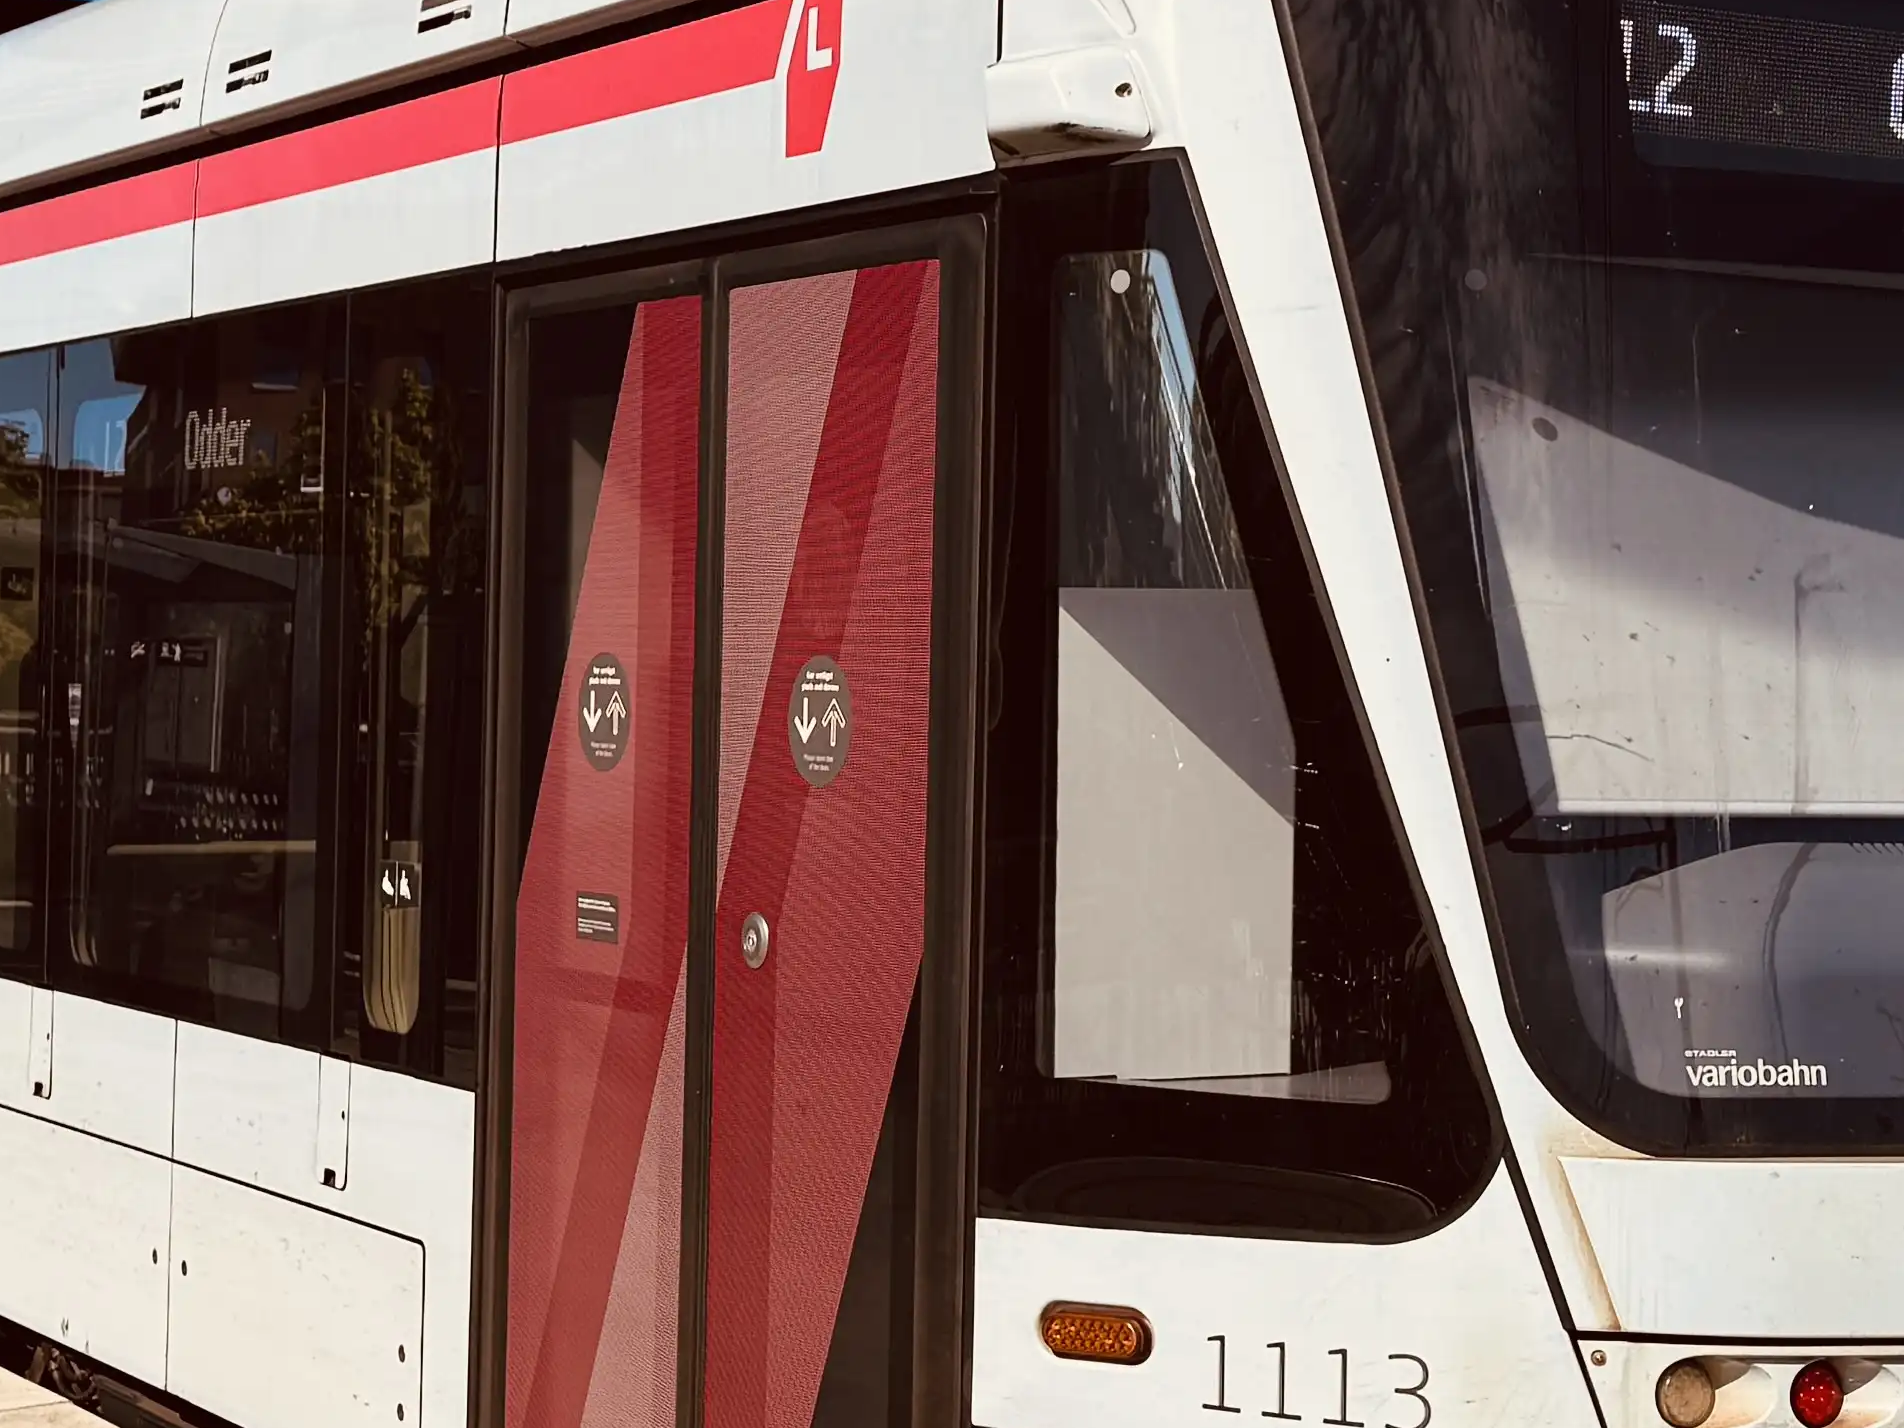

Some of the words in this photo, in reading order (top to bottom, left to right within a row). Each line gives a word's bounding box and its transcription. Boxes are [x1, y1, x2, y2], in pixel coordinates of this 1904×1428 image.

[806, 6, 833, 71] L
[184, 407, 251, 469] Odder
[1685, 1058, 1828, 1087] variobahn
